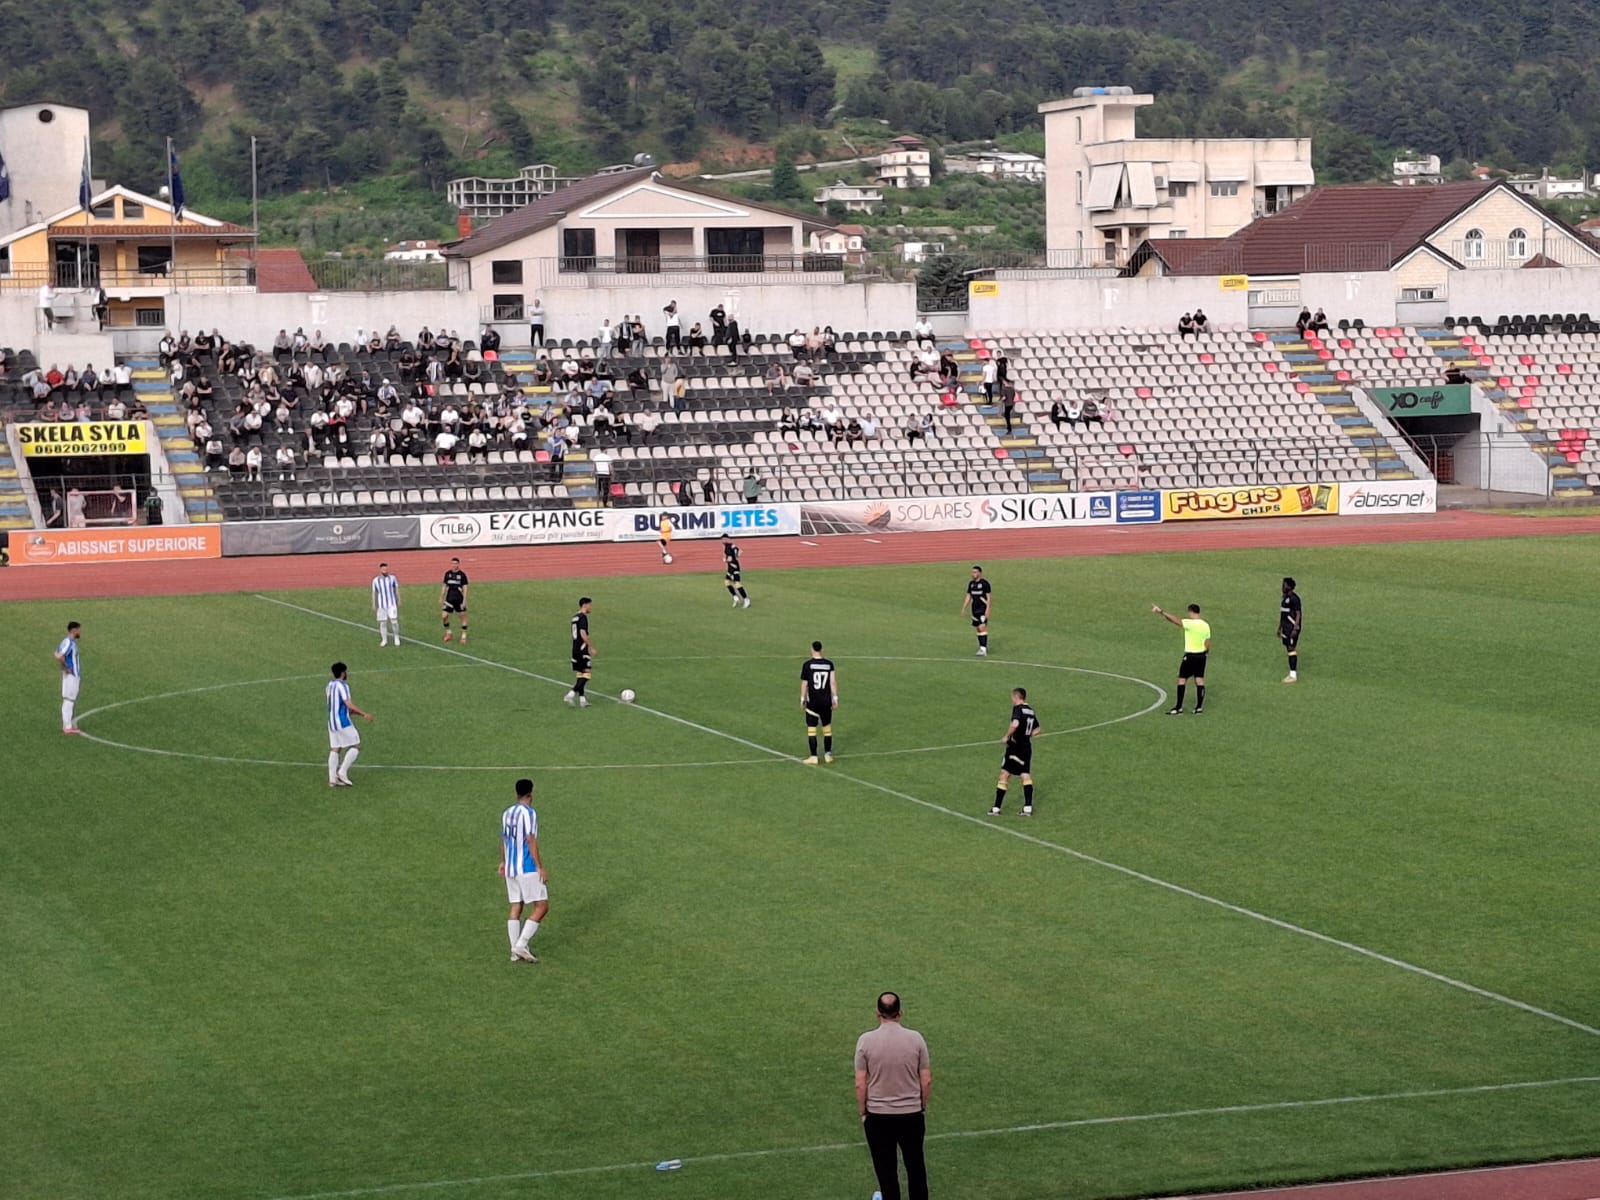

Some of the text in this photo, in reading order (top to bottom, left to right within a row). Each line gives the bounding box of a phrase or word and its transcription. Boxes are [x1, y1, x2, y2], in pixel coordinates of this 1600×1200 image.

[1389, 392, 1418, 411] XO
[19, 423, 141, 443] SKELA SYLA
[1001, 495, 1087, 523] SIGAL
[1169, 485, 1281, 515] Fingers
[1354, 490, 1426, 508] abissnet
[897, 501, 973, 522] SOLARES
[1242, 503, 1281, 516] CHIPS
[439, 523, 474, 535] TILBA
[489, 510, 605, 530] EXCHANGE
[634, 511, 715, 533] BURIMI
[58, 539, 125, 556] ABISSNET
[128, 536, 207, 553] SUPERIORE
[813, 671, 829, 690] 97
